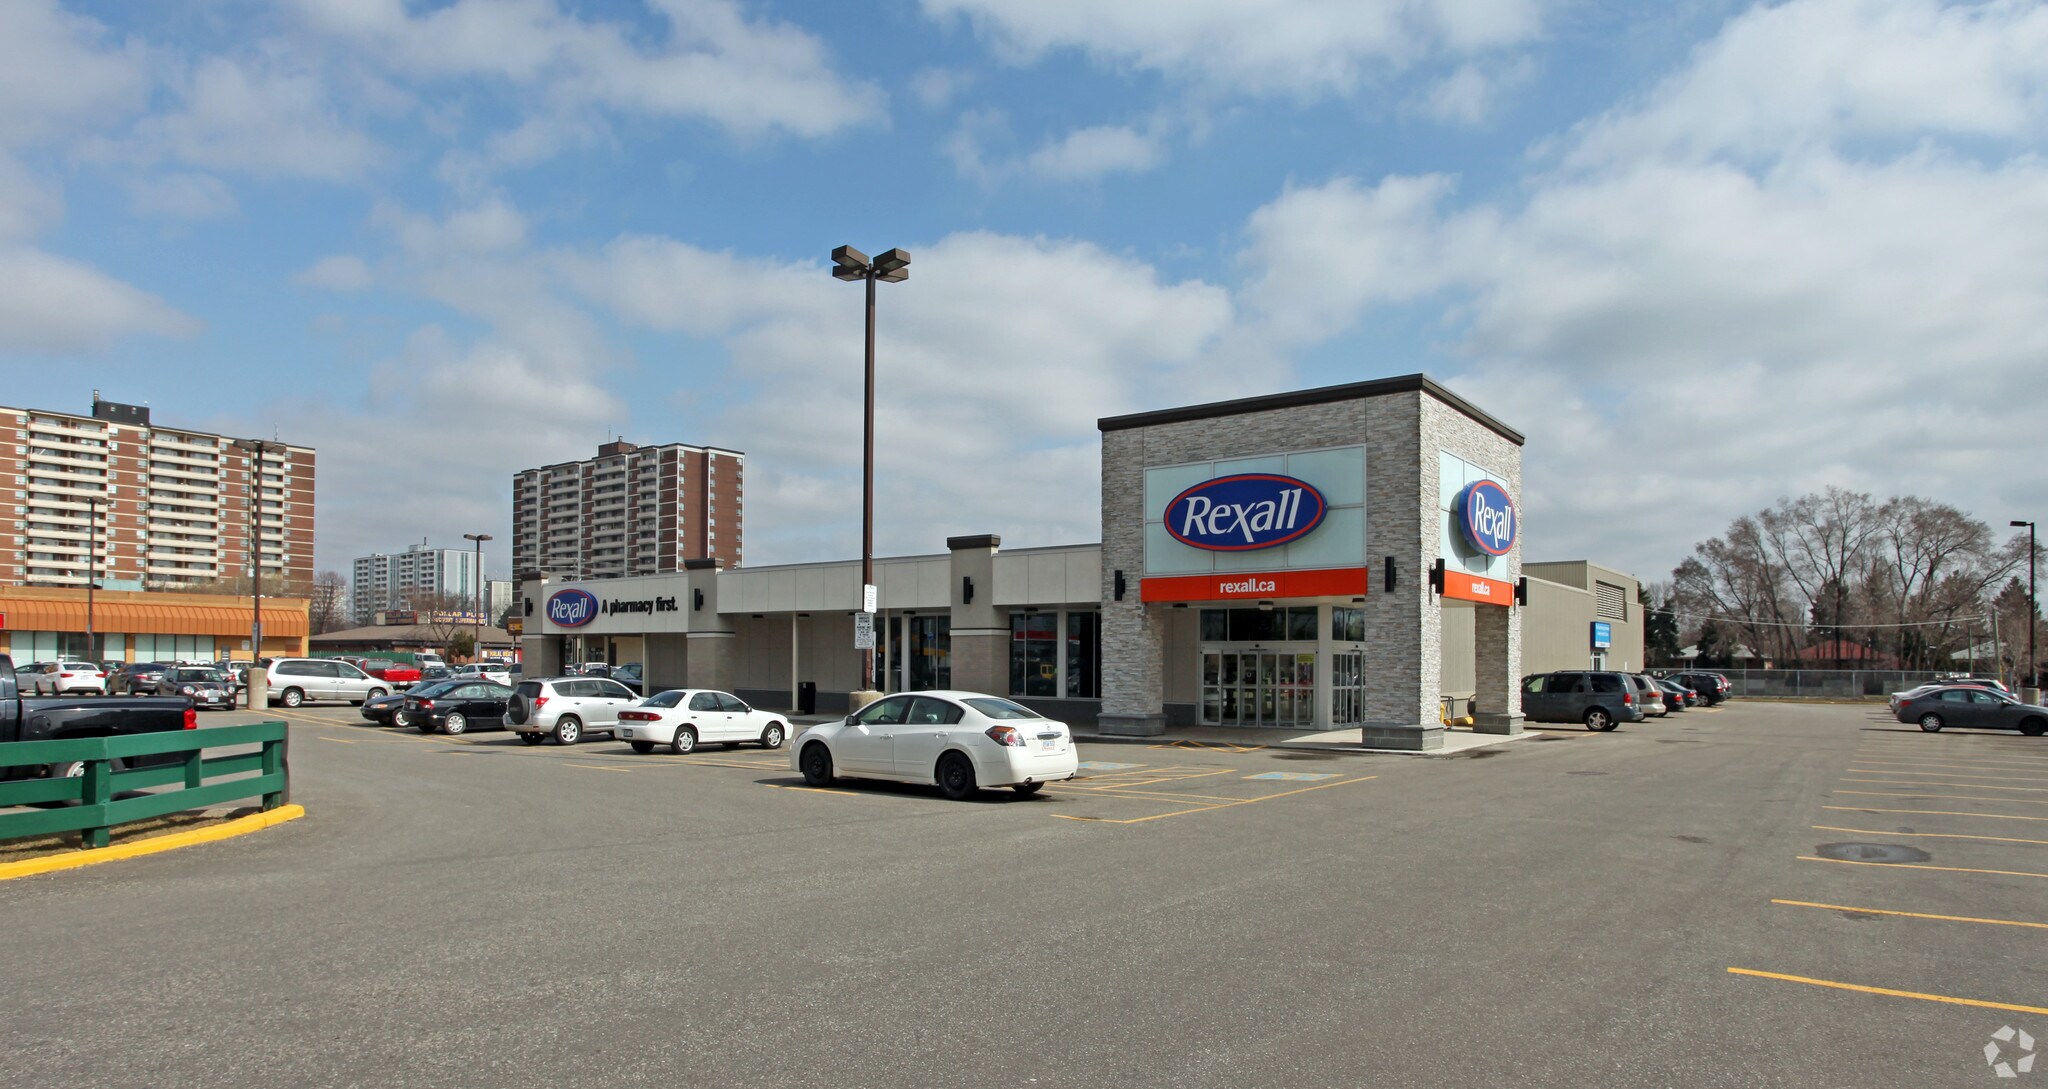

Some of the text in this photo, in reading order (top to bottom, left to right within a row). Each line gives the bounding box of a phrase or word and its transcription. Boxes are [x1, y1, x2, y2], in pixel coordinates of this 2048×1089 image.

[1182, 487, 1303, 543] Rexall
[1474, 491, 1512, 549] Rexall
[1219, 578, 1276, 594] rexall.ca
[1471, 581, 1491, 596] rexall.ca
[551, 597, 588, 624] Rexall
[601, 596, 678, 617] A pharmacy first.
